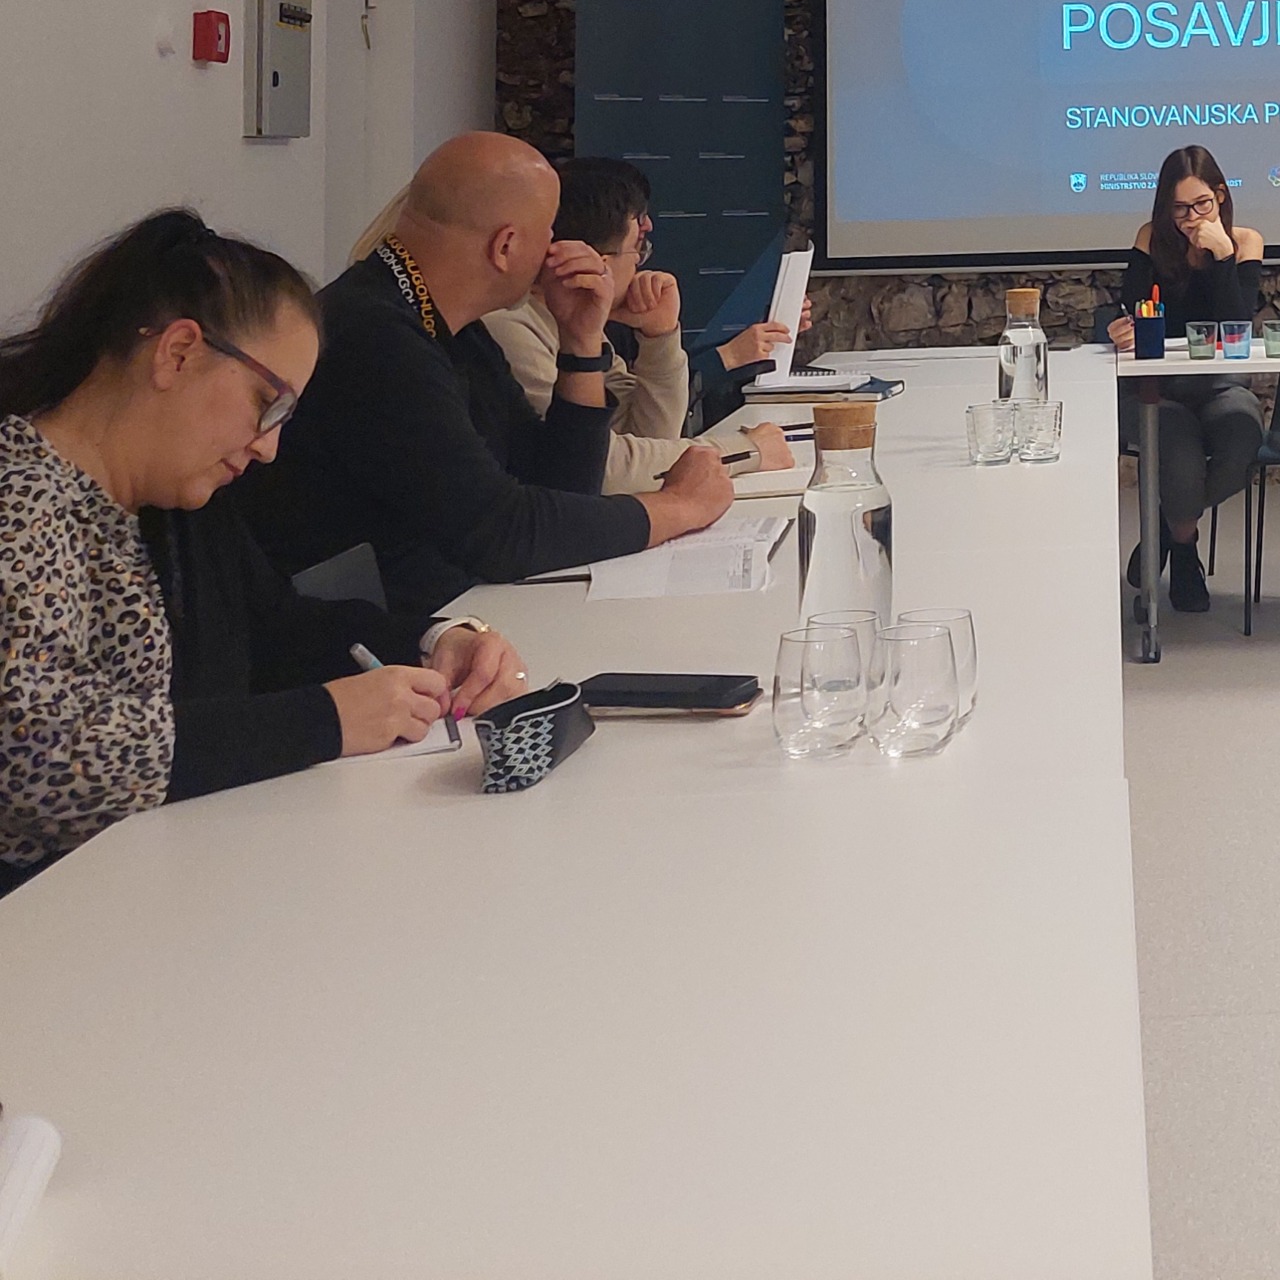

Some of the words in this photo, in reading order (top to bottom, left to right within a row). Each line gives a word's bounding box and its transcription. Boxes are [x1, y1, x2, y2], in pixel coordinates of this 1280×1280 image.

[1065, 103, 1259, 130] STANOVANJSKA
[1100, 173, 1139, 181] REPUBLIKA
[1100, 182, 1146, 190] MINISTRSTVO
